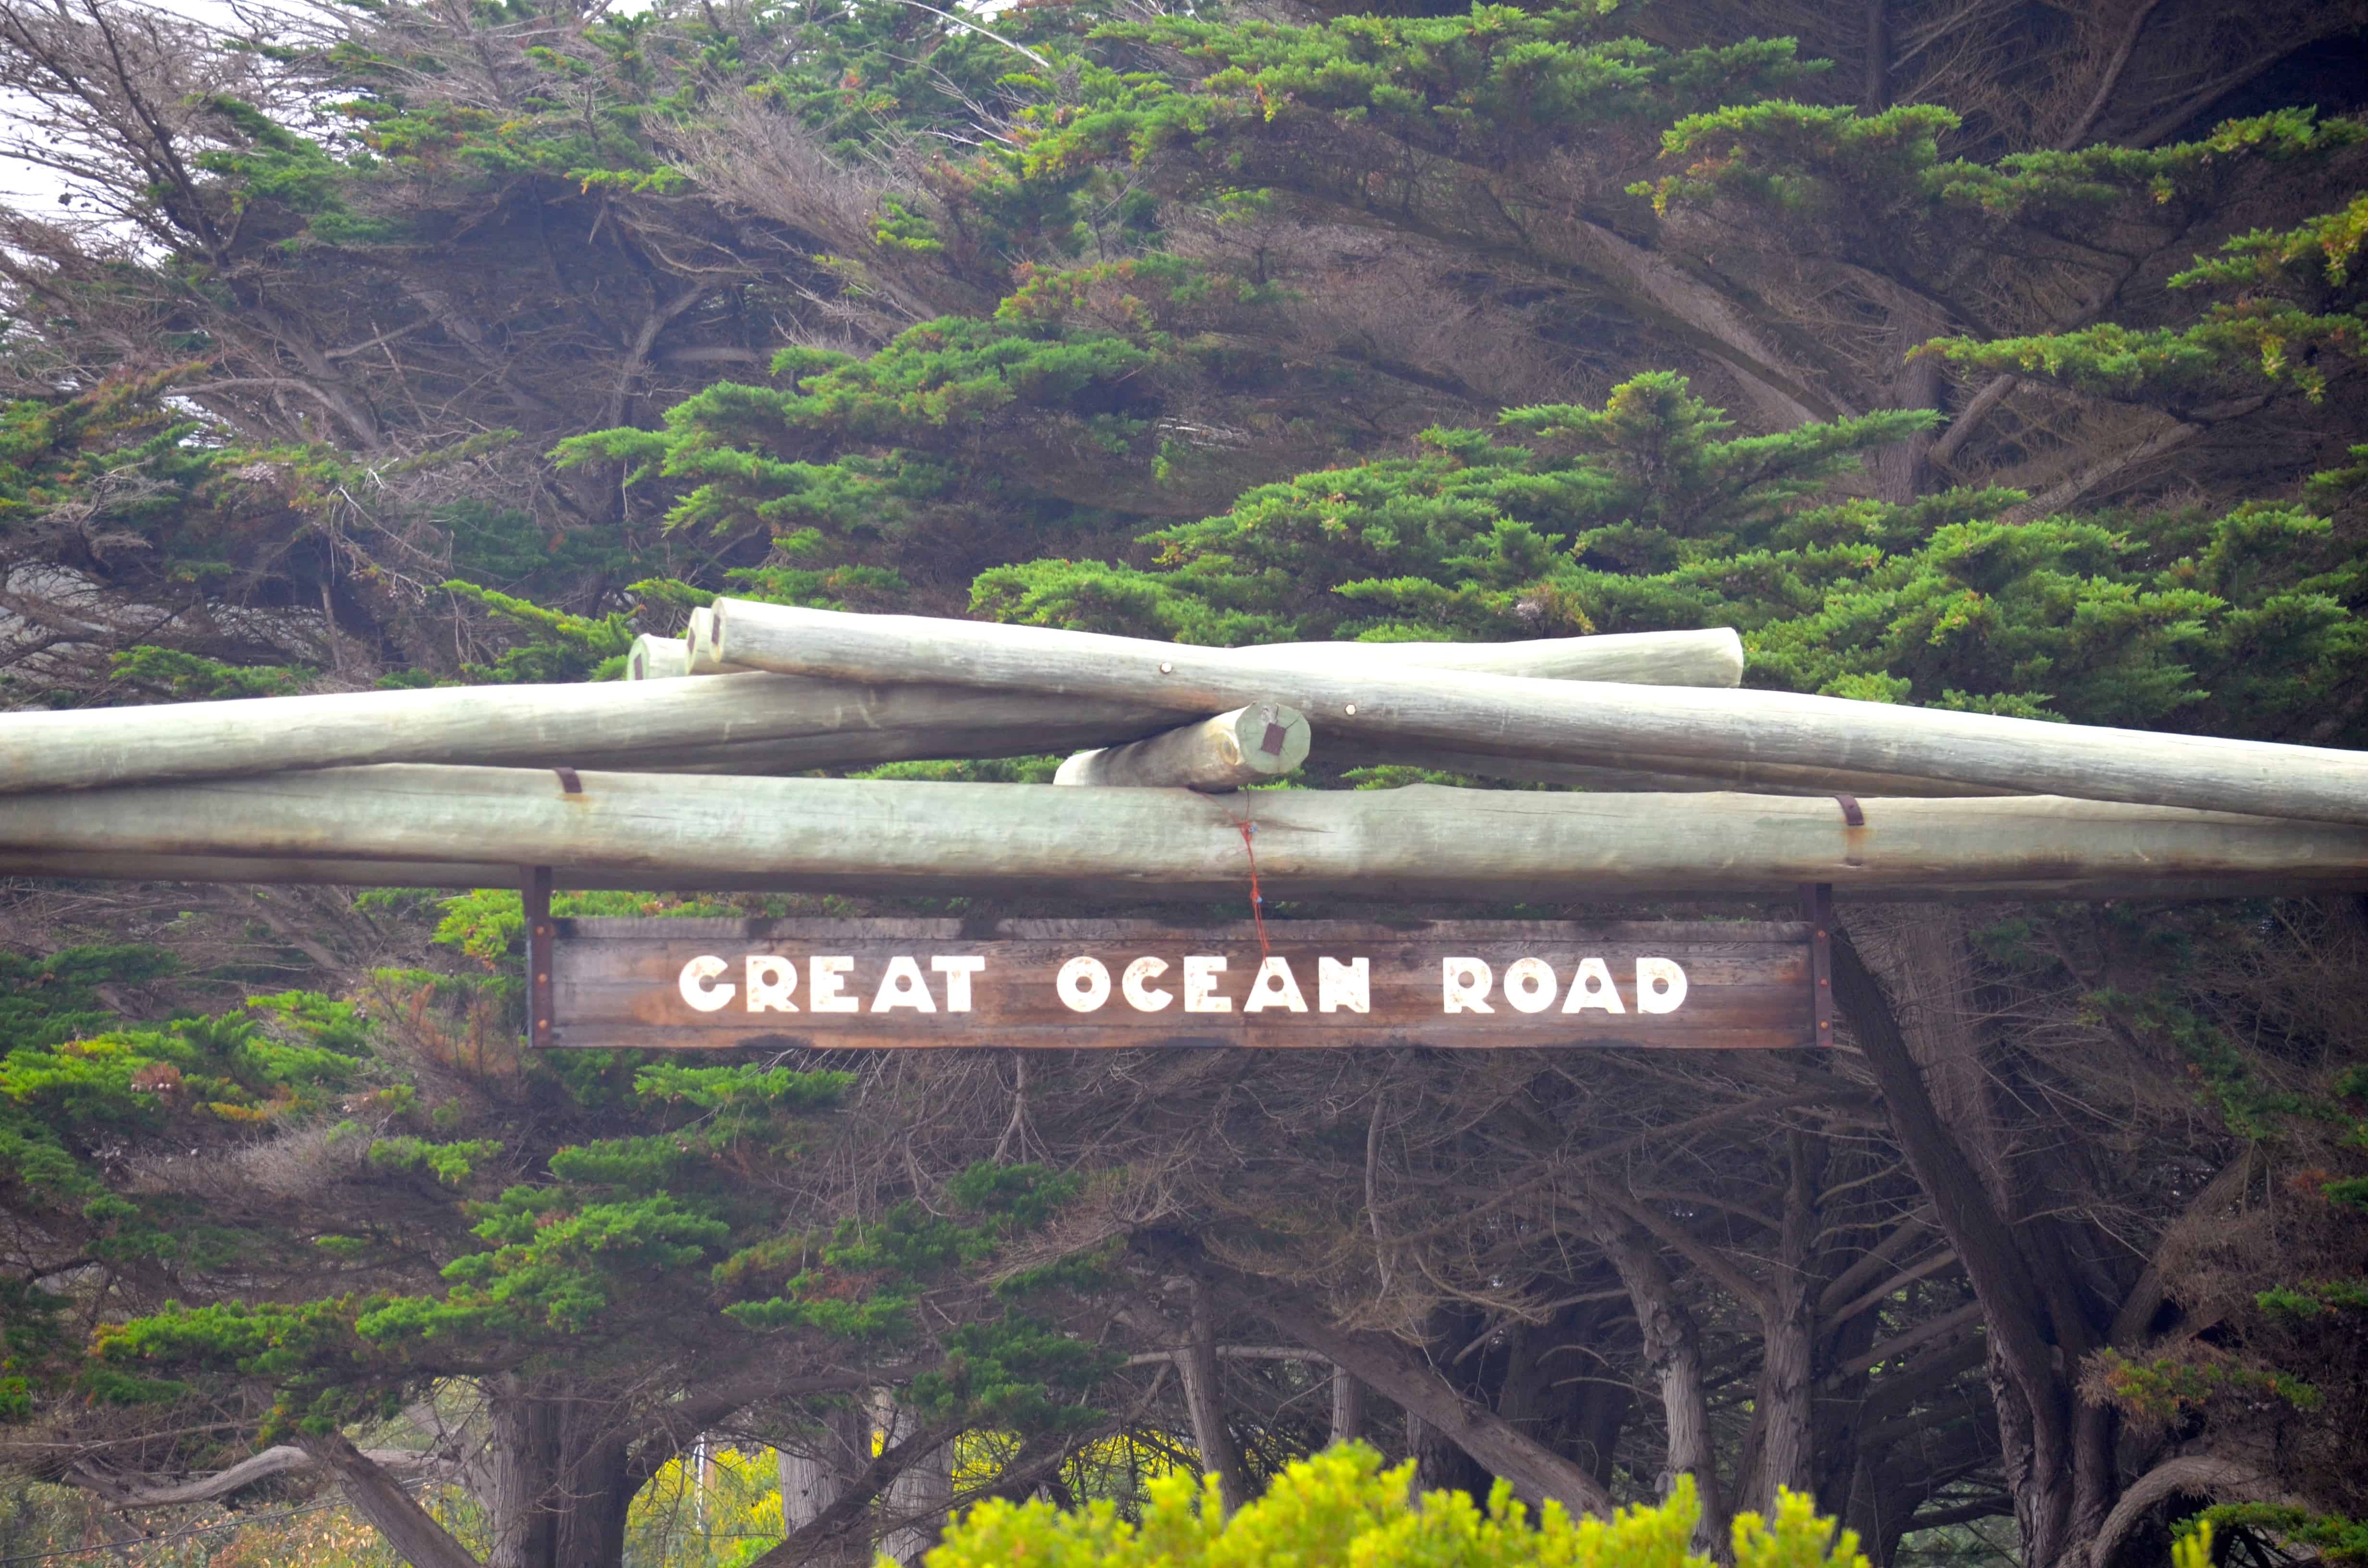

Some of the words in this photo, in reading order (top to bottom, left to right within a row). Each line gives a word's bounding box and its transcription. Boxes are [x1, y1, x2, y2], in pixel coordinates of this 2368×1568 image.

[678, 955, 986, 1014] GREAT
[1056, 955, 1371, 1014] OCEAN
[1442, 956, 1689, 1015] ROAD
